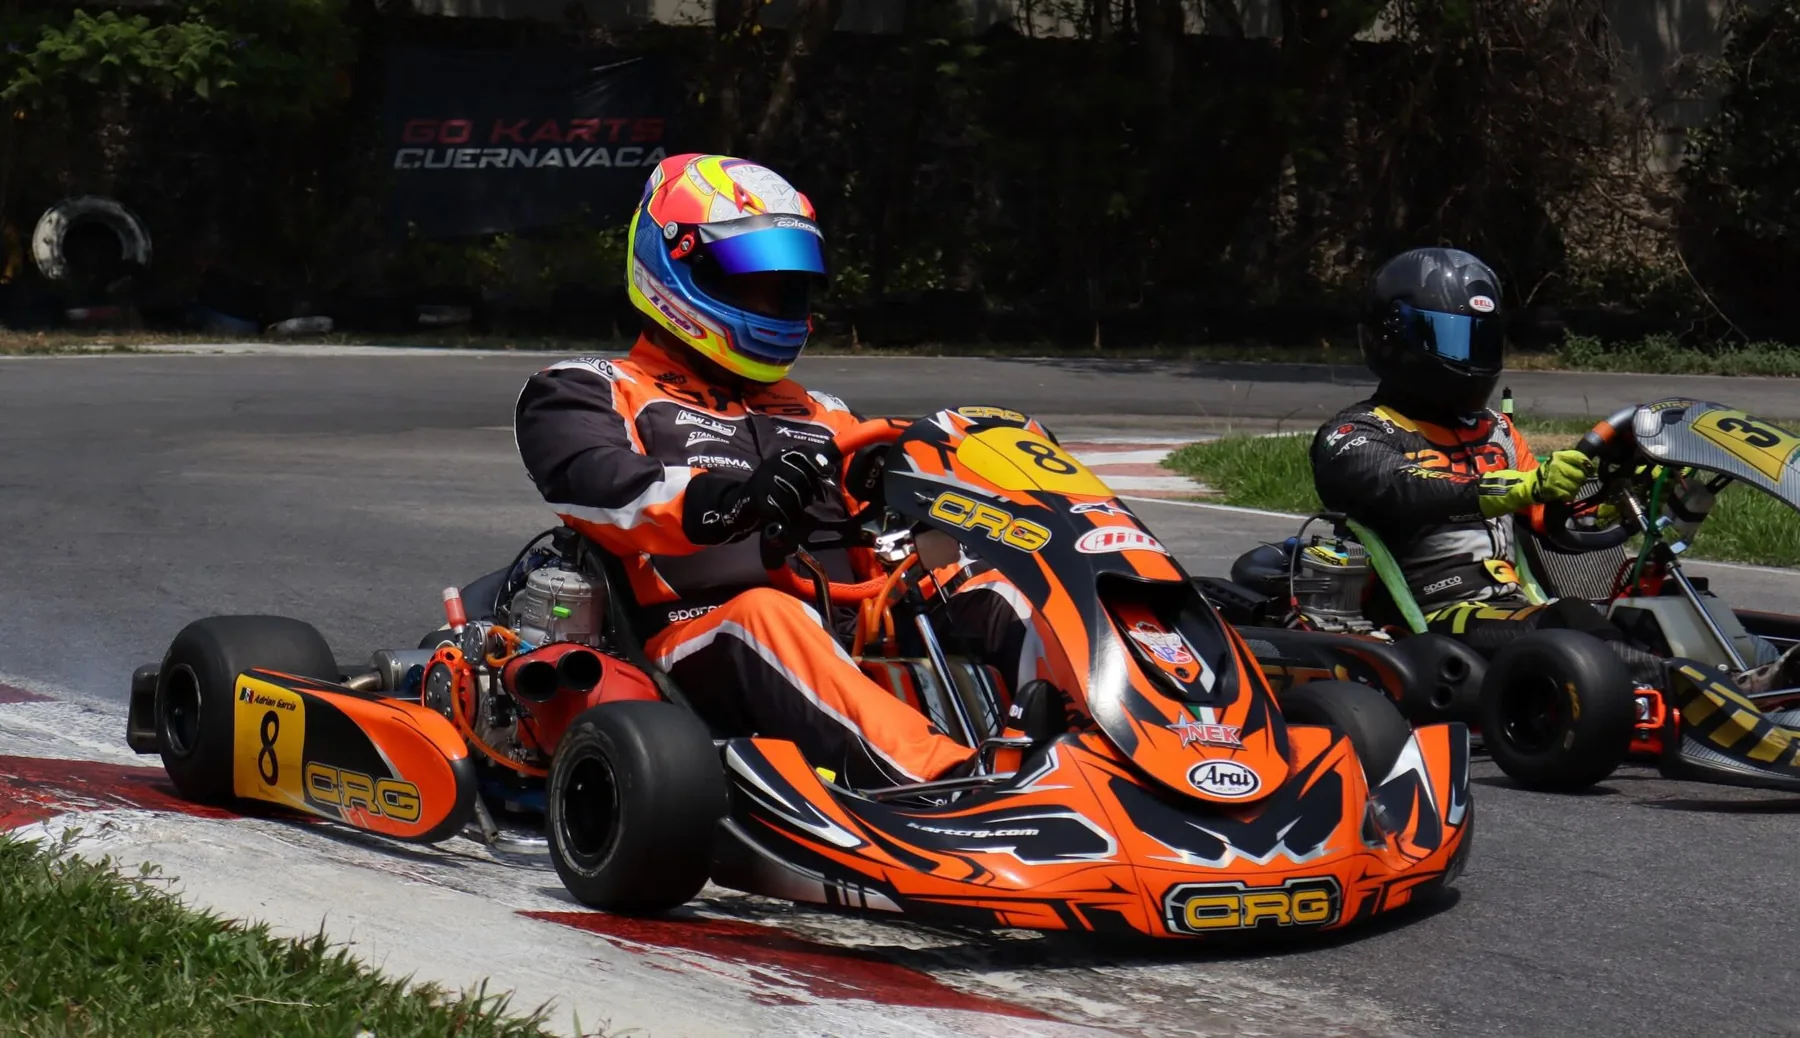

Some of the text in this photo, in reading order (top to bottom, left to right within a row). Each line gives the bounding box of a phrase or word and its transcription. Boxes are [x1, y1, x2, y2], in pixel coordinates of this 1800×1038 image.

[402, 117, 666, 144] GO KARTS
[394, 146, 669, 169] CUERNAVACA
[958, 406, 1027, 423] CRG
[687, 455, 752, 470] PRISMA
[1015, 440, 1078, 475] 8
[928, 491, 1053, 553] CRG
[1423, 576, 1462, 594] sparco
[668, 604, 722, 622] sparc
[1187, 723, 1242, 745] NEK
[258, 710, 280, 786] 8
[1195, 765, 1251, 787] Arai
[305, 761, 422, 824] CRG
[1184, 888, 1332, 931] CRG
